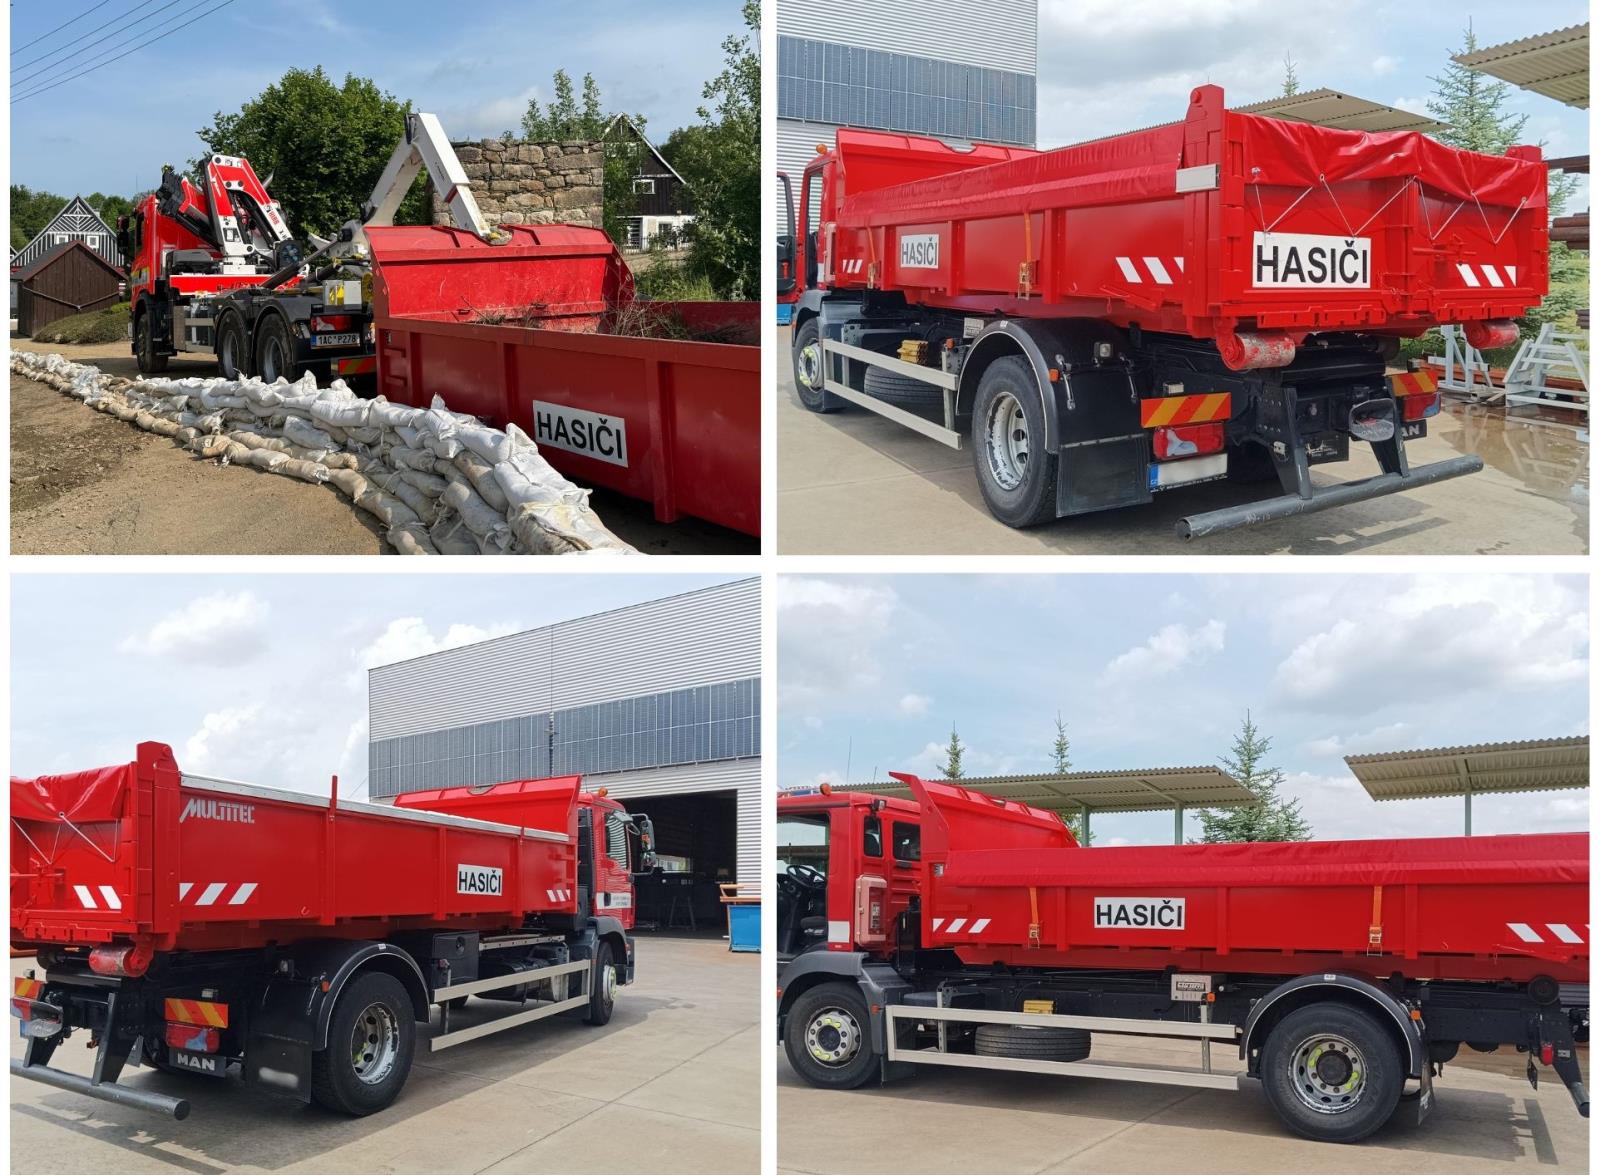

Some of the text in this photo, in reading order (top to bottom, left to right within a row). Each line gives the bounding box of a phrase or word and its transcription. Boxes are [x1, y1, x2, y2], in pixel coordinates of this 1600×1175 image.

[902, 236, 938, 266] HASIČI
[1257, 240, 1368, 284] HASIČI
[537, 411, 623, 459] HASIČI
[1400, 424, 1420, 437] AN
[179, 798, 256, 824] MULTITEC
[458, 869, 502, 893] HASIČI
[1096, 899, 1183, 928] HASIČI
[177, 1052, 216, 1071] MAN
